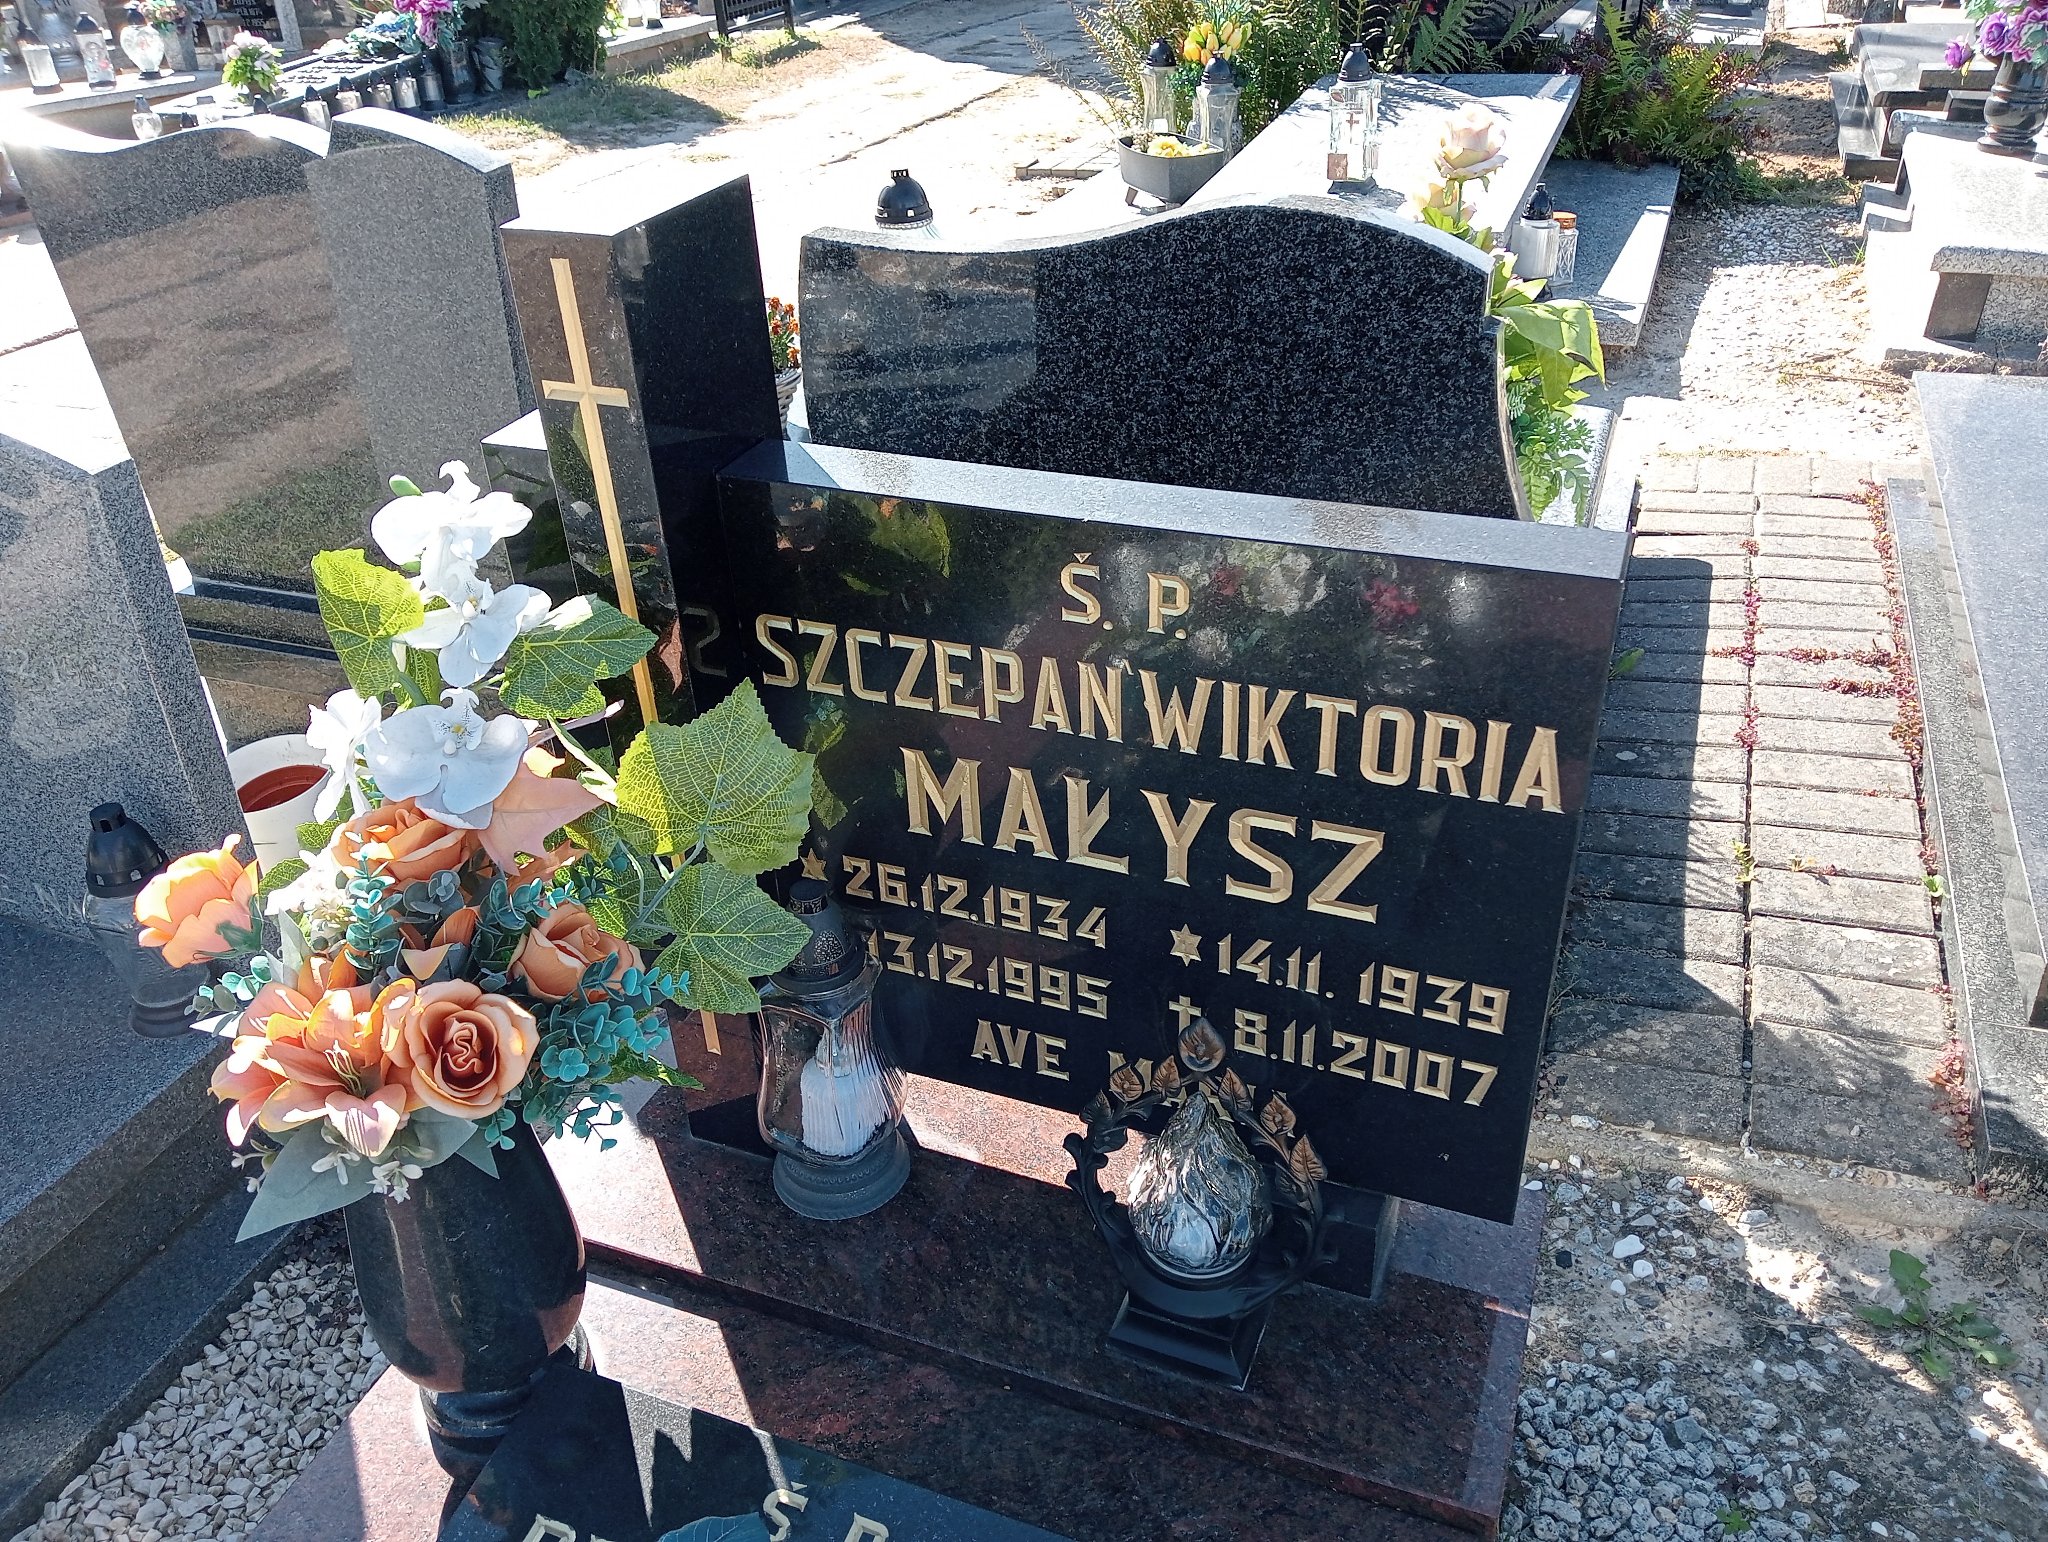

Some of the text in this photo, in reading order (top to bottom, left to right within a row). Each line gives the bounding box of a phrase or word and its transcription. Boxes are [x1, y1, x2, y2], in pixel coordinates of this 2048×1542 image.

[1146, 572, 1190, 640] P.
[1138, 668, 1566, 815] WIKTORIA
[900, 746, 1386, 924] MAŁYSZ
[842, 854, 1107, 950] 26.12.1934
[867, 929, 1113, 1020] 13.12.1995
[1216, 933, 1511, 1036] 14.11. 1939
[970, 1018, 1071, 1082] AVE
[1233, 1007, 1499, 1107] 8.11.2007
